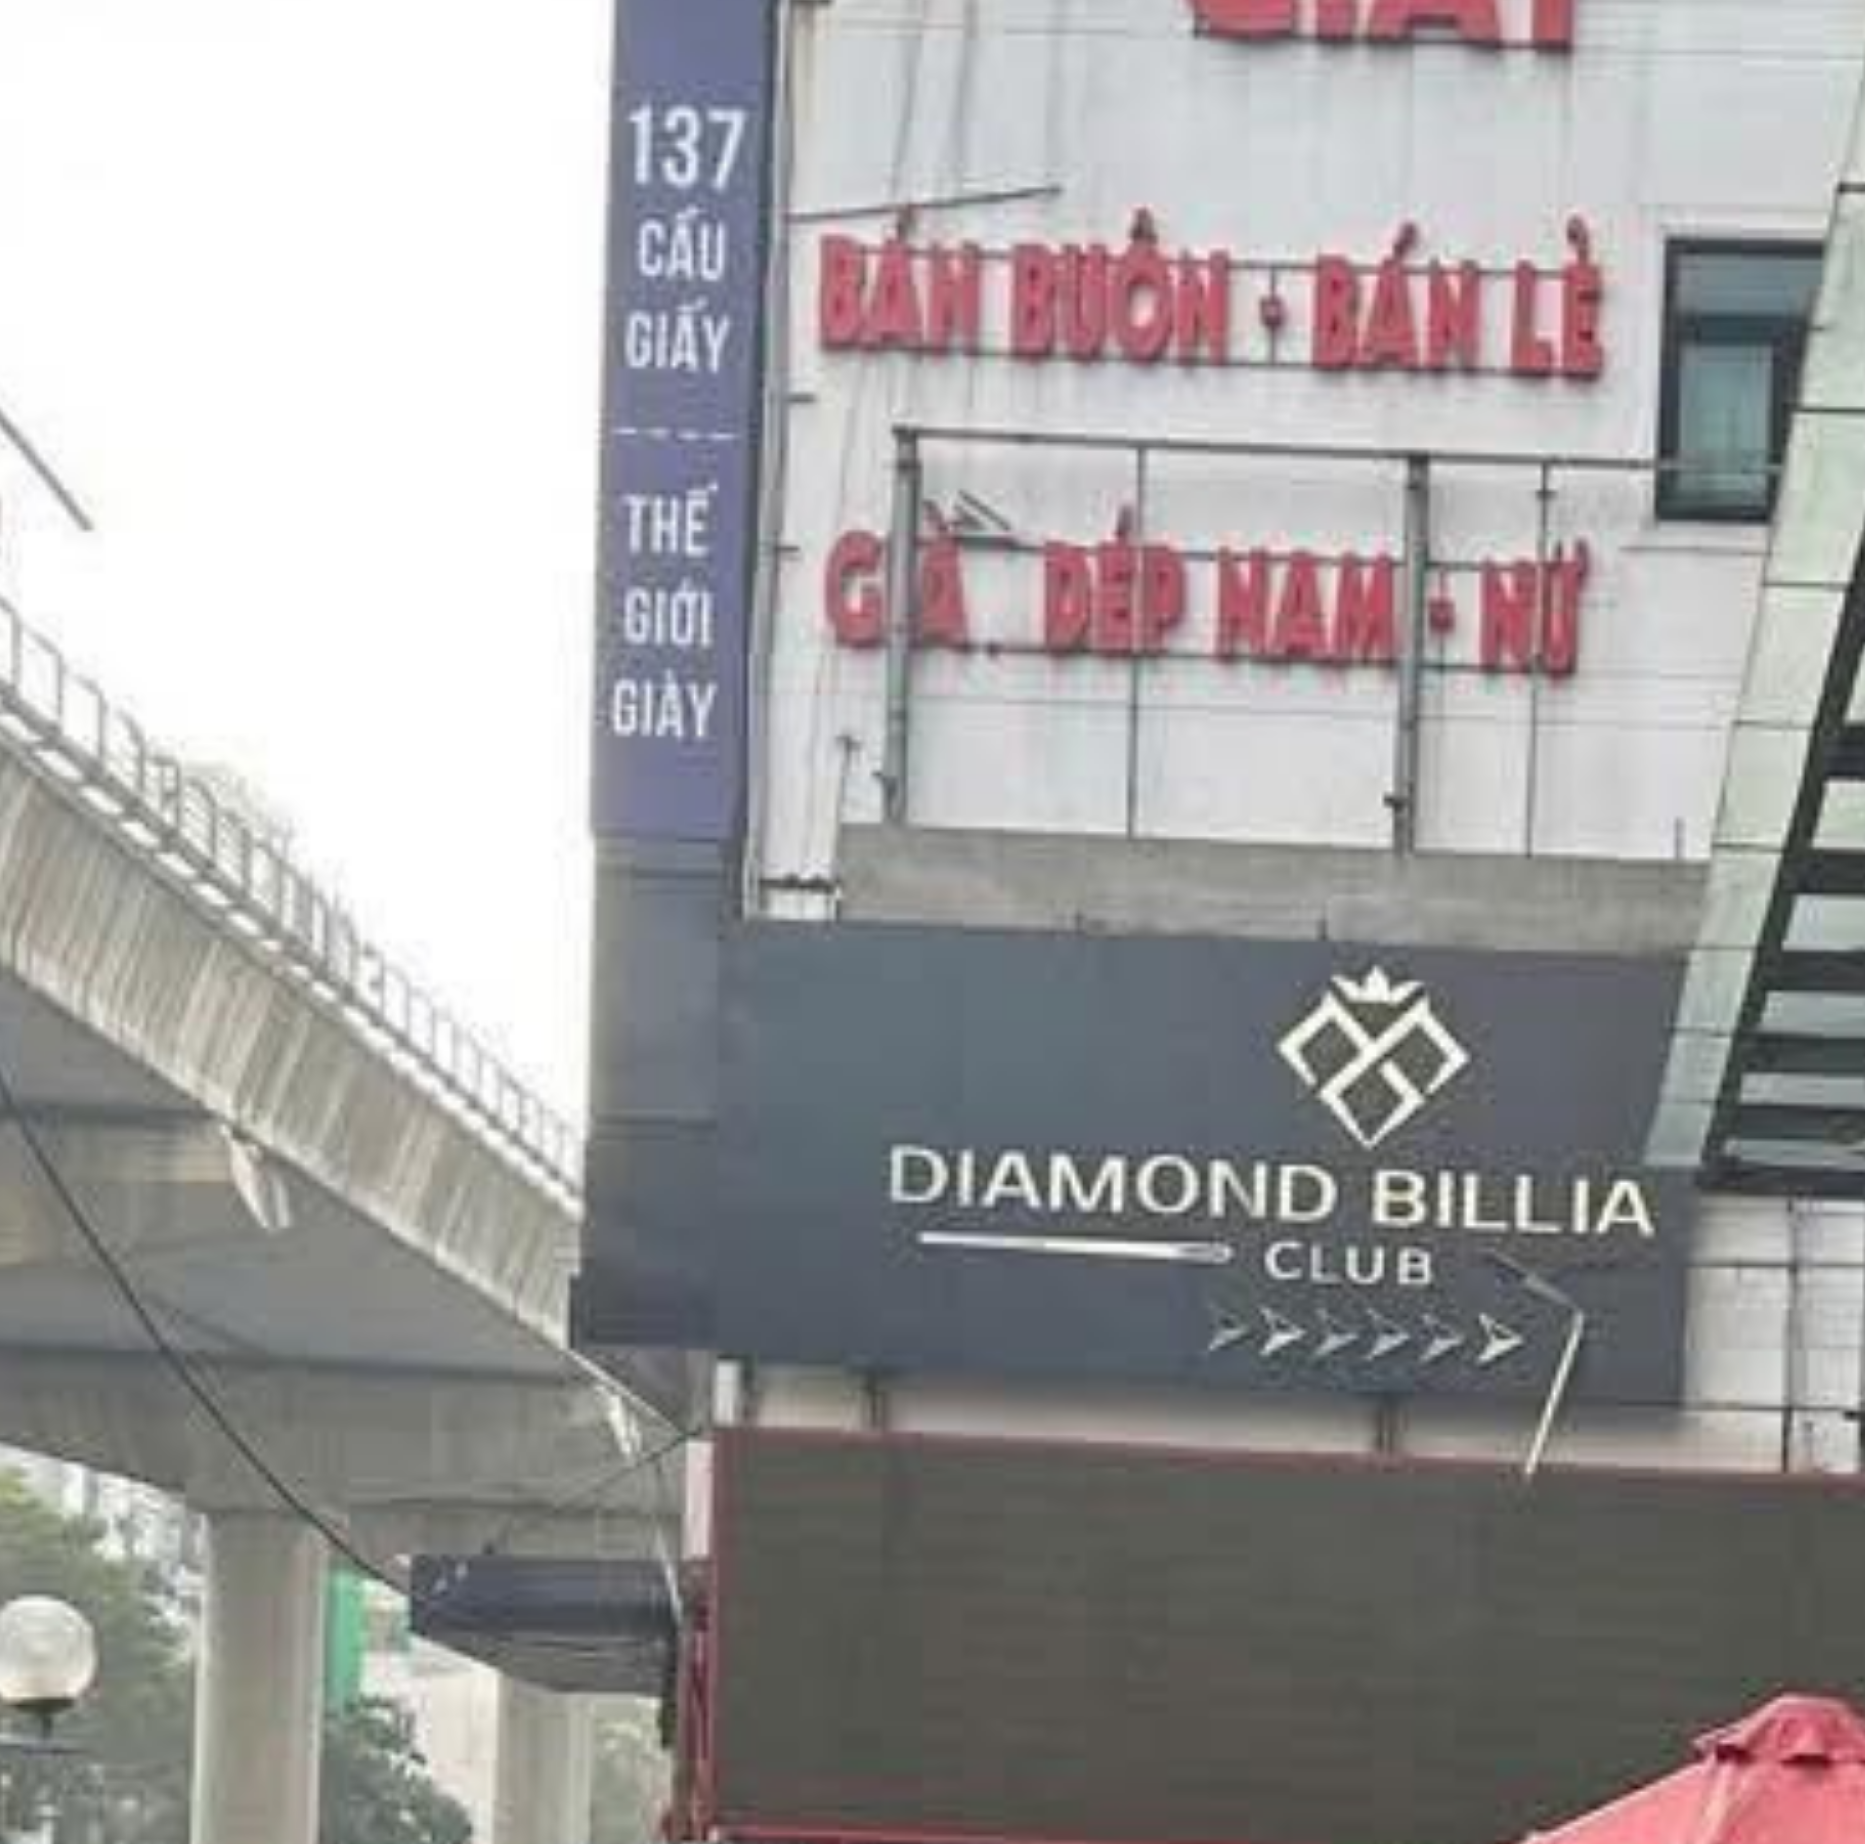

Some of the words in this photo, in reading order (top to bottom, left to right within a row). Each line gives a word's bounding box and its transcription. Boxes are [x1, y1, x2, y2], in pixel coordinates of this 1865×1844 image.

[628, 103, 746, 190] 137
[819, 205, 982, 353] BÁN
[1012, 207, 1230, 364] BUÔN
[1312, 221, 1482, 370] BÁN
[1512, 215, 1606, 380] LẺ
[624, 297, 731, 373] GIẤY
[622, 482, 719, 557] THẾ
[623, 577, 714, 648] GIỚI
[1215, 546, 1396, 666] NAM
[613, 666, 718, 737] GIÀY
[889, 1143, 1339, 1225] DIAMOND
[1371, 1168, 1657, 1240] BILLIA
[1263, 1239, 1435, 1287] CLUB
